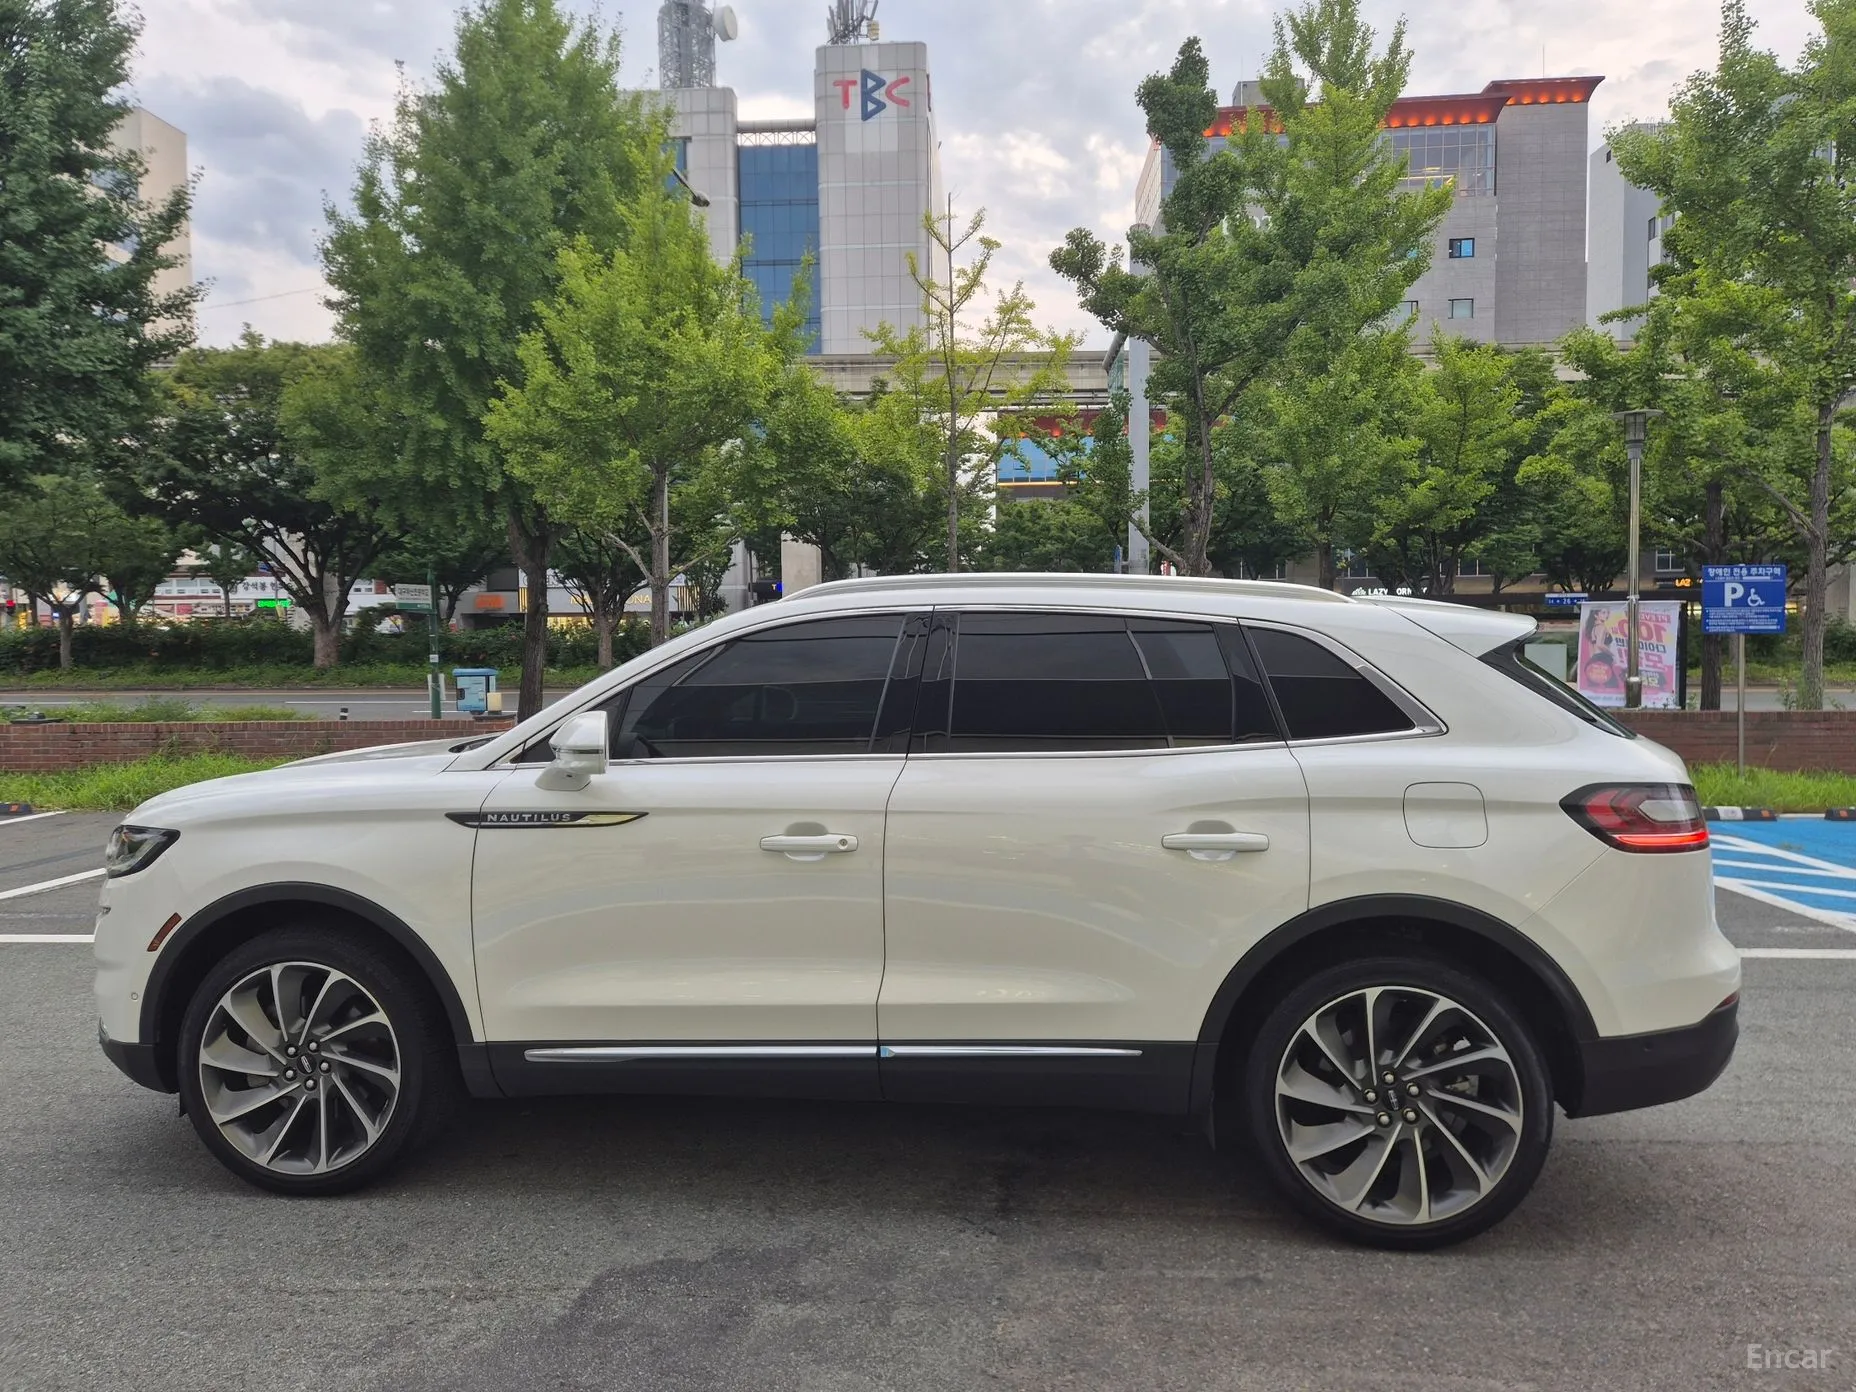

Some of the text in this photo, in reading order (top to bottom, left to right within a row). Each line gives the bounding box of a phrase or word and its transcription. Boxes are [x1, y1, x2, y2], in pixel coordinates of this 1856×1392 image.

[833, 68, 910, 121] TBC
[1708, 567, 1781, 577] 장애인 전용 주차구역
[1368, 587, 1389, 596] LAZY
[1724, 582, 1745, 607] P
[486, 813, 571, 822] NAUTILUS
